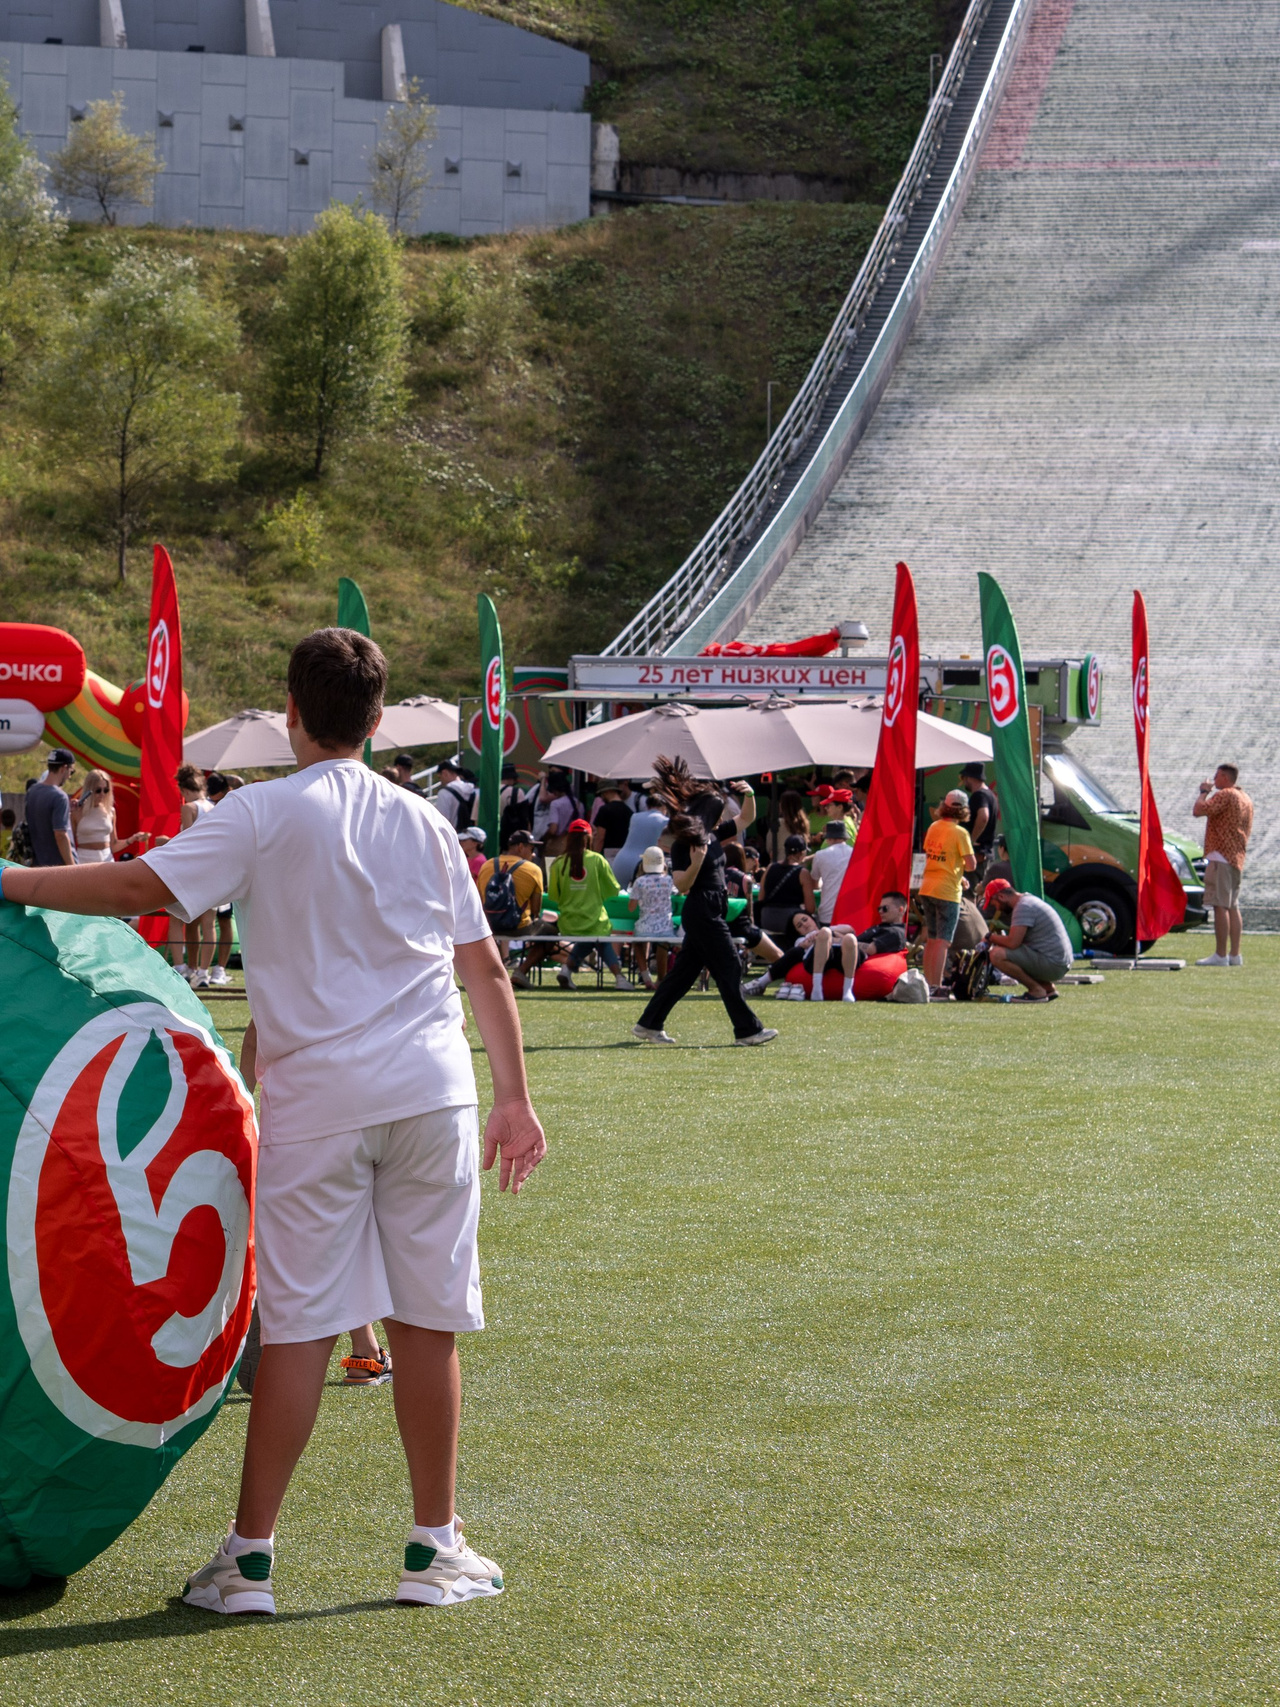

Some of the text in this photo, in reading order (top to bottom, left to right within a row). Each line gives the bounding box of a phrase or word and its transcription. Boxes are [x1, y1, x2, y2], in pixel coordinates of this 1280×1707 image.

[638, 666, 866, 687] 25 лет низких цен
